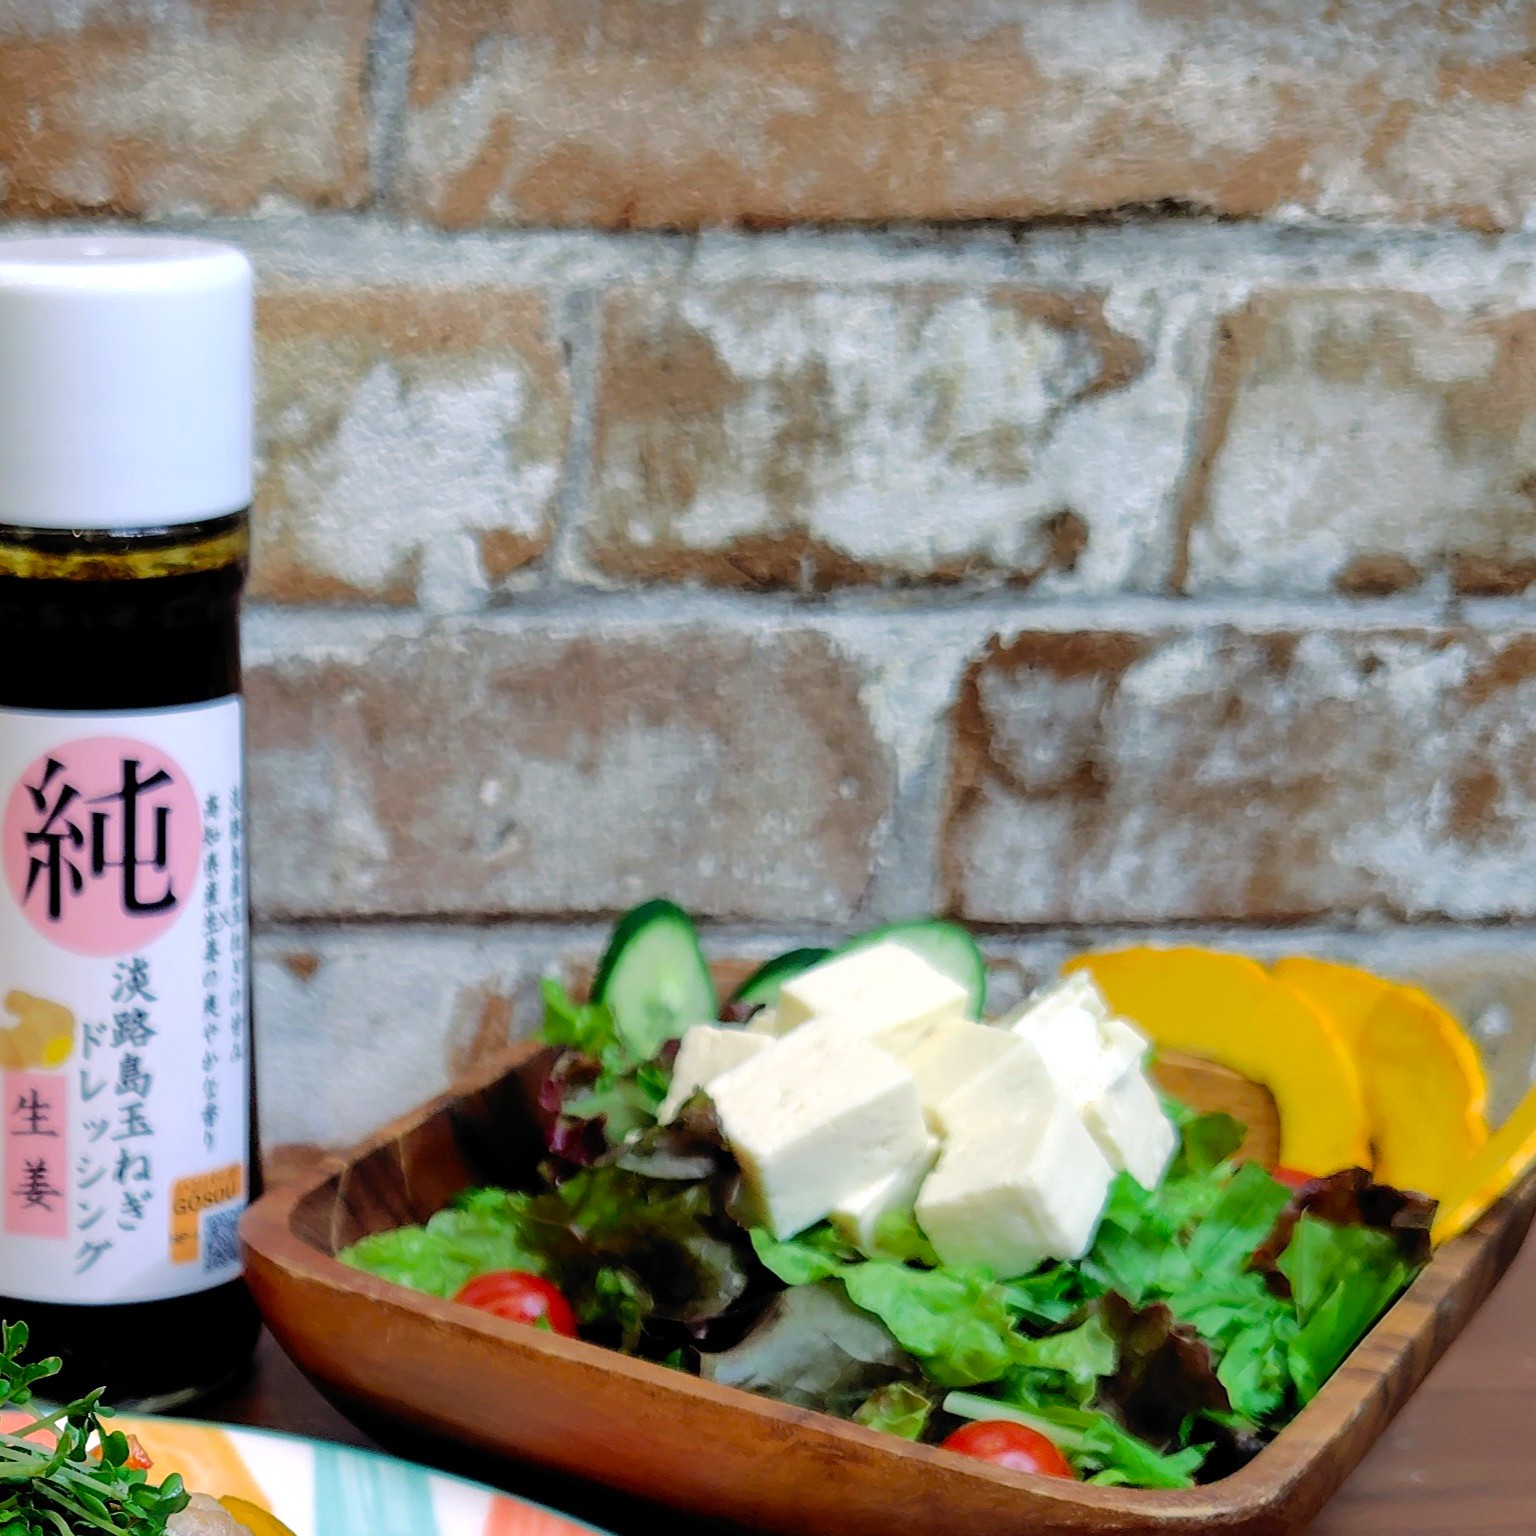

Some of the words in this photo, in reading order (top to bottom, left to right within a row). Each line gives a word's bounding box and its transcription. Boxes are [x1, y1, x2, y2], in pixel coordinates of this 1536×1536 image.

[22, 755, 177, 922] 純
[11, 1087, 61, 1212] 生姜
[75, 1021, 114, 1276] ドレッシング
[110, 957, 156, 1231] 淡路島玉ねぎ
